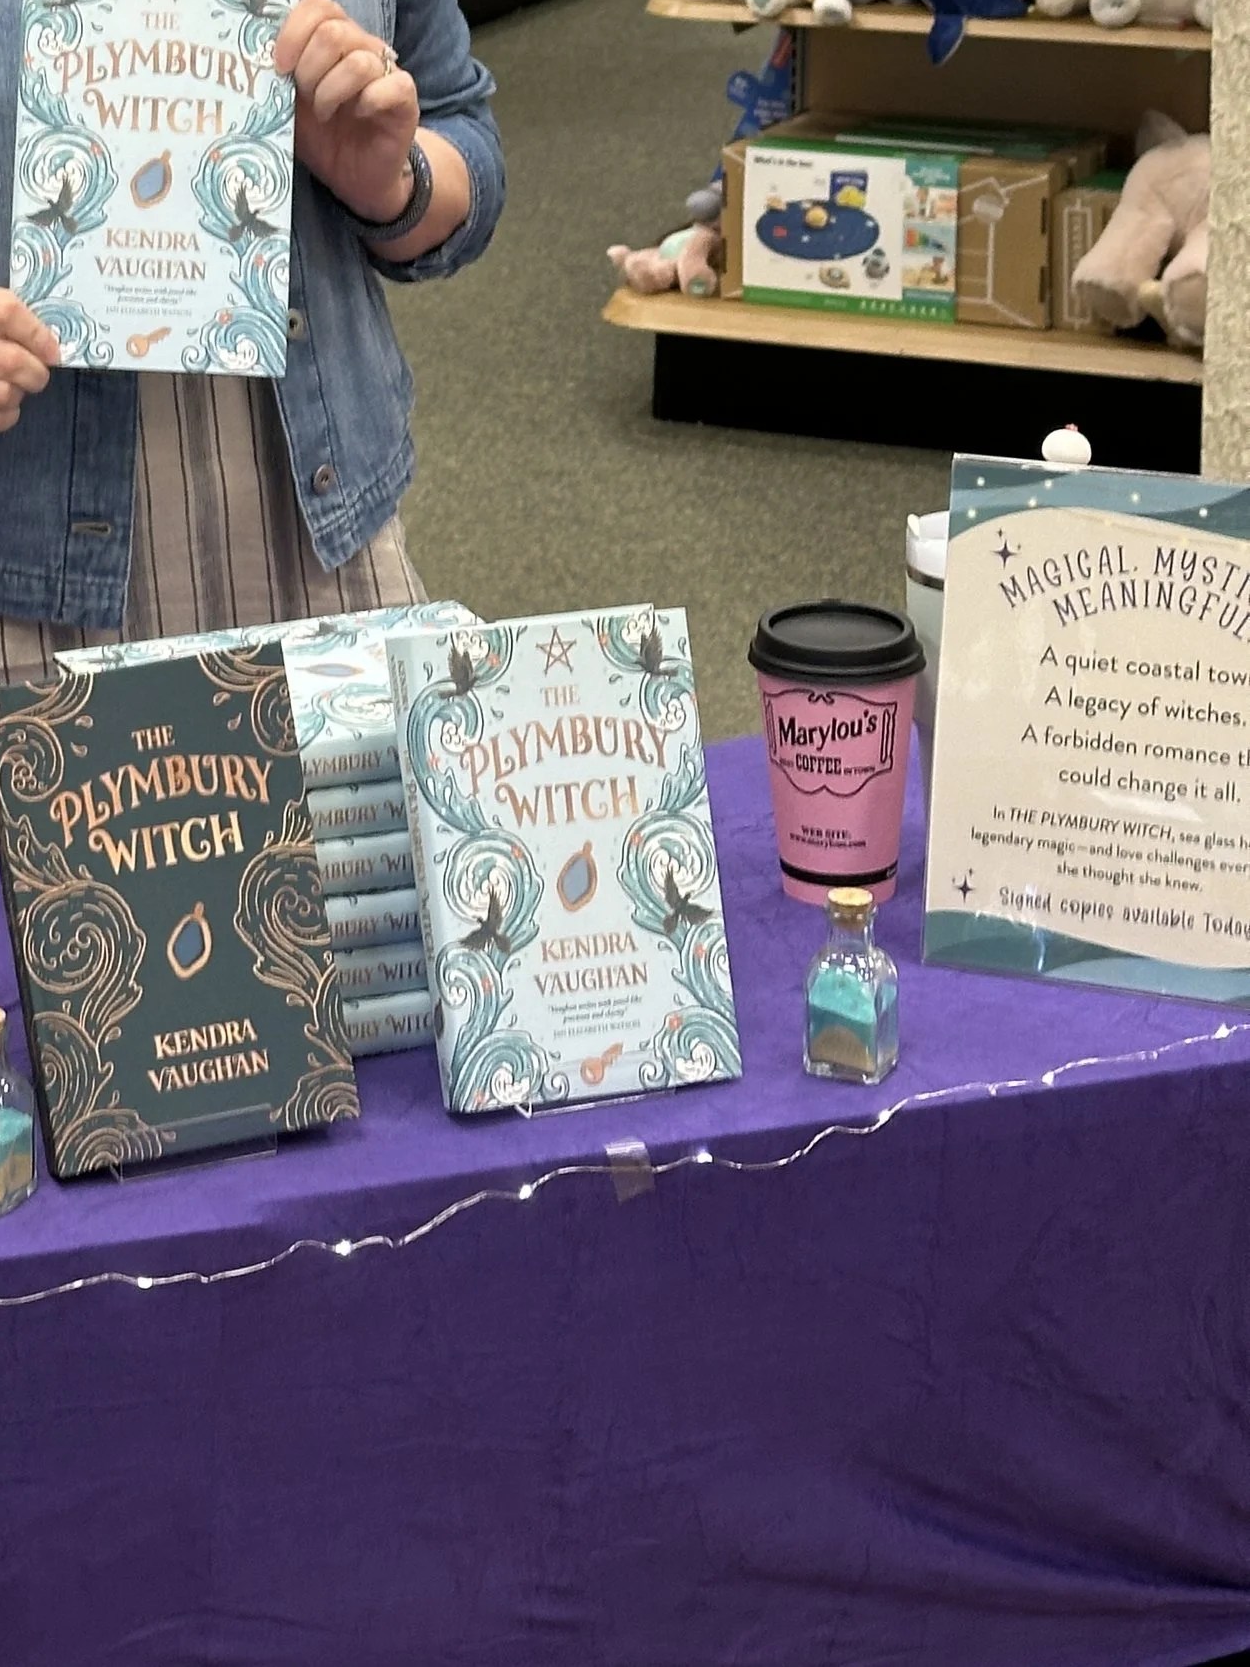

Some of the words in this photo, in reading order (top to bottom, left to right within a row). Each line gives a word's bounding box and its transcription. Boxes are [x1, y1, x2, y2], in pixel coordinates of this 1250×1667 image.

[141, 9, 181, 33] THE
[52, 36, 265, 98] PLYMBURY
[81, 86, 224, 137] WITCH
[105, 228, 201, 253] KENDRA
[93, 255, 209, 283] VAUGHAN
[998, 543, 1141, 611] MAGICAL.
[1153, 546, 1250, 602] MYSTI
[1040, 646, 1059, 667] A
[1064, 647, 1119, 677] quiet
[1125, 656, 1200, 684] coastal
[539, 685, 580, 707] THE
[1044, 686, 1063, 708] A
[1067, 689, 1131, 722] legacy
[1136, 696, 1160, 717] of
[1163, 700, 1248, 728] witches.
[131, 724, 176, 751] THE
[778, 709, 878, 752] Marylou's
[1020, 724, 1040, 745] A
[1043, 725, 1138, 757] forbidden
[1143, 741, 1232, 768] romance
[303, 749, 382, 776] LYMBURY
[458, 713, 672, 798] PLYMBURY
[795, 752, 842, 776] COFFEE
[49, 753, 274, 848] PLYMBURY
[494, 775, 641, 829] WITCH
[1057, 767, 1112, 790] could
[1116, 774, 1190, 803] change
[1193, 780, 1209, 801] it
[1212, 780, 1242, 804] all.
[87, 810, 246, 876] WITCH
[993, 804, 1006, 821] In
[1008, 806, 1037, 825] THE
[1040, 810, 1121, 834] PLYMBURY
[1122, 820, 1175, 843] WITCH,
[1179, 831, 1200, 843] sea
[1204, 832, 1236, 850] glass
[970, 826, 1033, 852] legendary
[1116, 845, 1142, 861] love
[1146, 848, 1215, 872] challenges
[1057, 861, 1078, 877] she
[1082, 866, 1134, 886] thought
[1138, 871, 1160, 886] she
[1164, 875, 1203, 894] knew.
[999, 885, 1052, 912] Signed
[1060, 896, 1114, 922] copies
[1123, 902, 1195, 932] available
[541, 931, 639, 965] KENDRA
[533, 961, 650, 998] VAUGHAN
[153, 1018, 258, 1060] KENDRA
[147, 1048, 270, 1094] VAUGHAN
